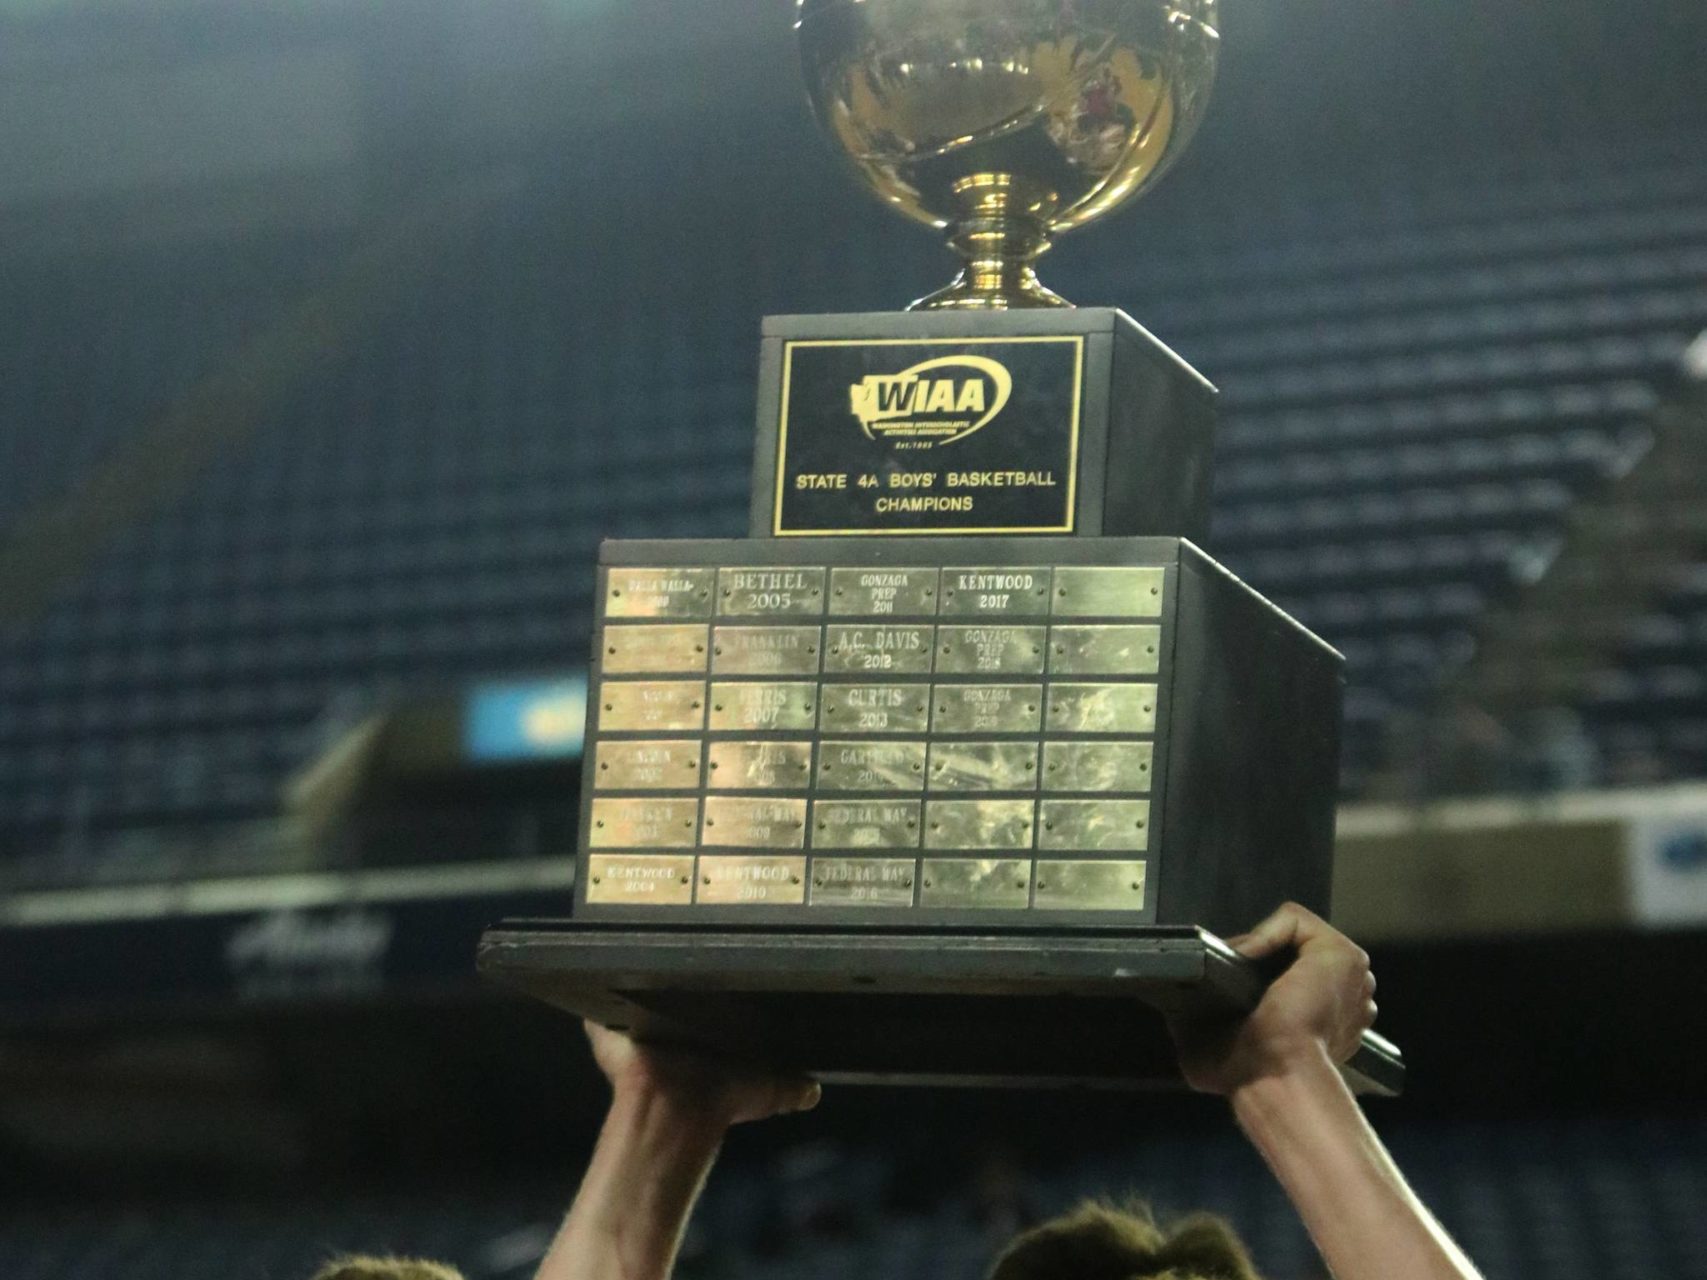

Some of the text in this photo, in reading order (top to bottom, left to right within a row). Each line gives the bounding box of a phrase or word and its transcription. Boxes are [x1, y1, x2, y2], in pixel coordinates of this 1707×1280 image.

[877, 375, 985, 413] WIAA
[796, 471, 1056, 490] STATE 4A BOYS' BASKETBALL
[875, 496, 974, 513] CHAMPIONS
[733, 573, 808, 590] BETHEL
[861, 574, 909, 588] GONZAGA
[959, 575, 1033, 591] KENTWOOD
[748, 593, 791, 609] 2005
[871, 588, 898, 600] PREP
[979, 595, 1010, 609] 2017
[873, 600, 894, 614] 2011
[876, 632, 920, 650] DAVIS
[964, 630, 1016, 644] GONZAGA
[863, 654, 893, 669] 2012
[849, 688, 903, 707] CURTIS
[858, 713, 888, 728] 2013
